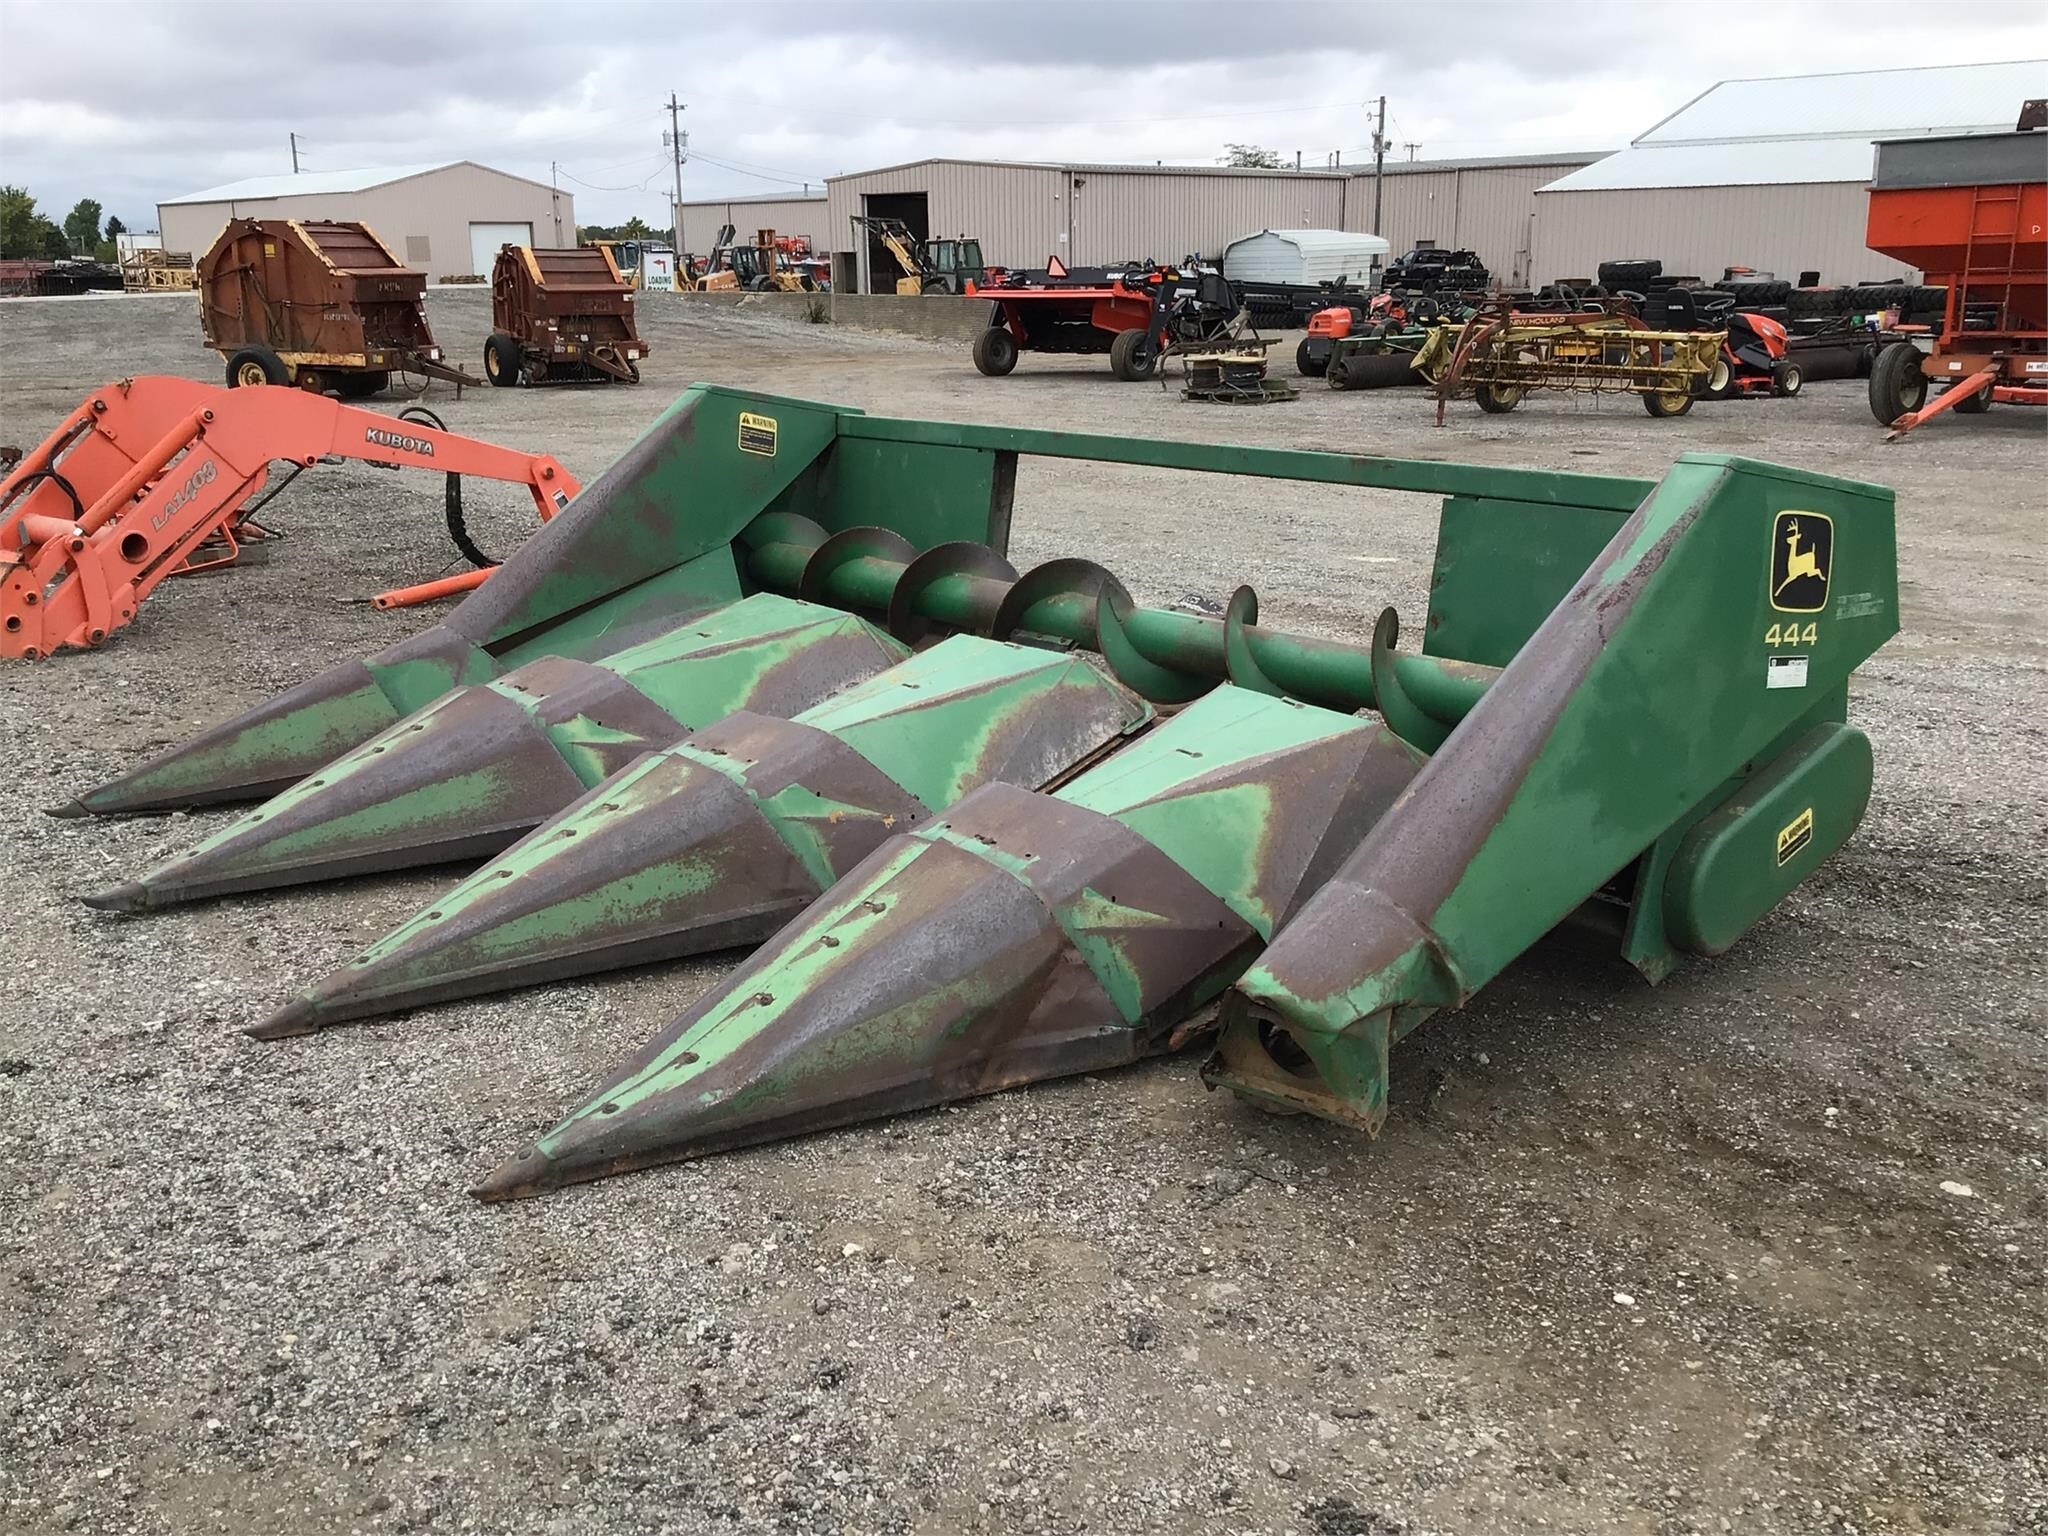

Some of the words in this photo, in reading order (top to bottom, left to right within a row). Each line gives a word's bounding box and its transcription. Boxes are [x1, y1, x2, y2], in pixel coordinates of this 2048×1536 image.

[647, 275, 672, 285] LOADING
[1528, 316, 1566, 325] HOLLAND
[752, 416, 776, 430] WARNING
[366, 427, 435, 457] KUBOTA
[1764, 622, 1818, 648] 444
